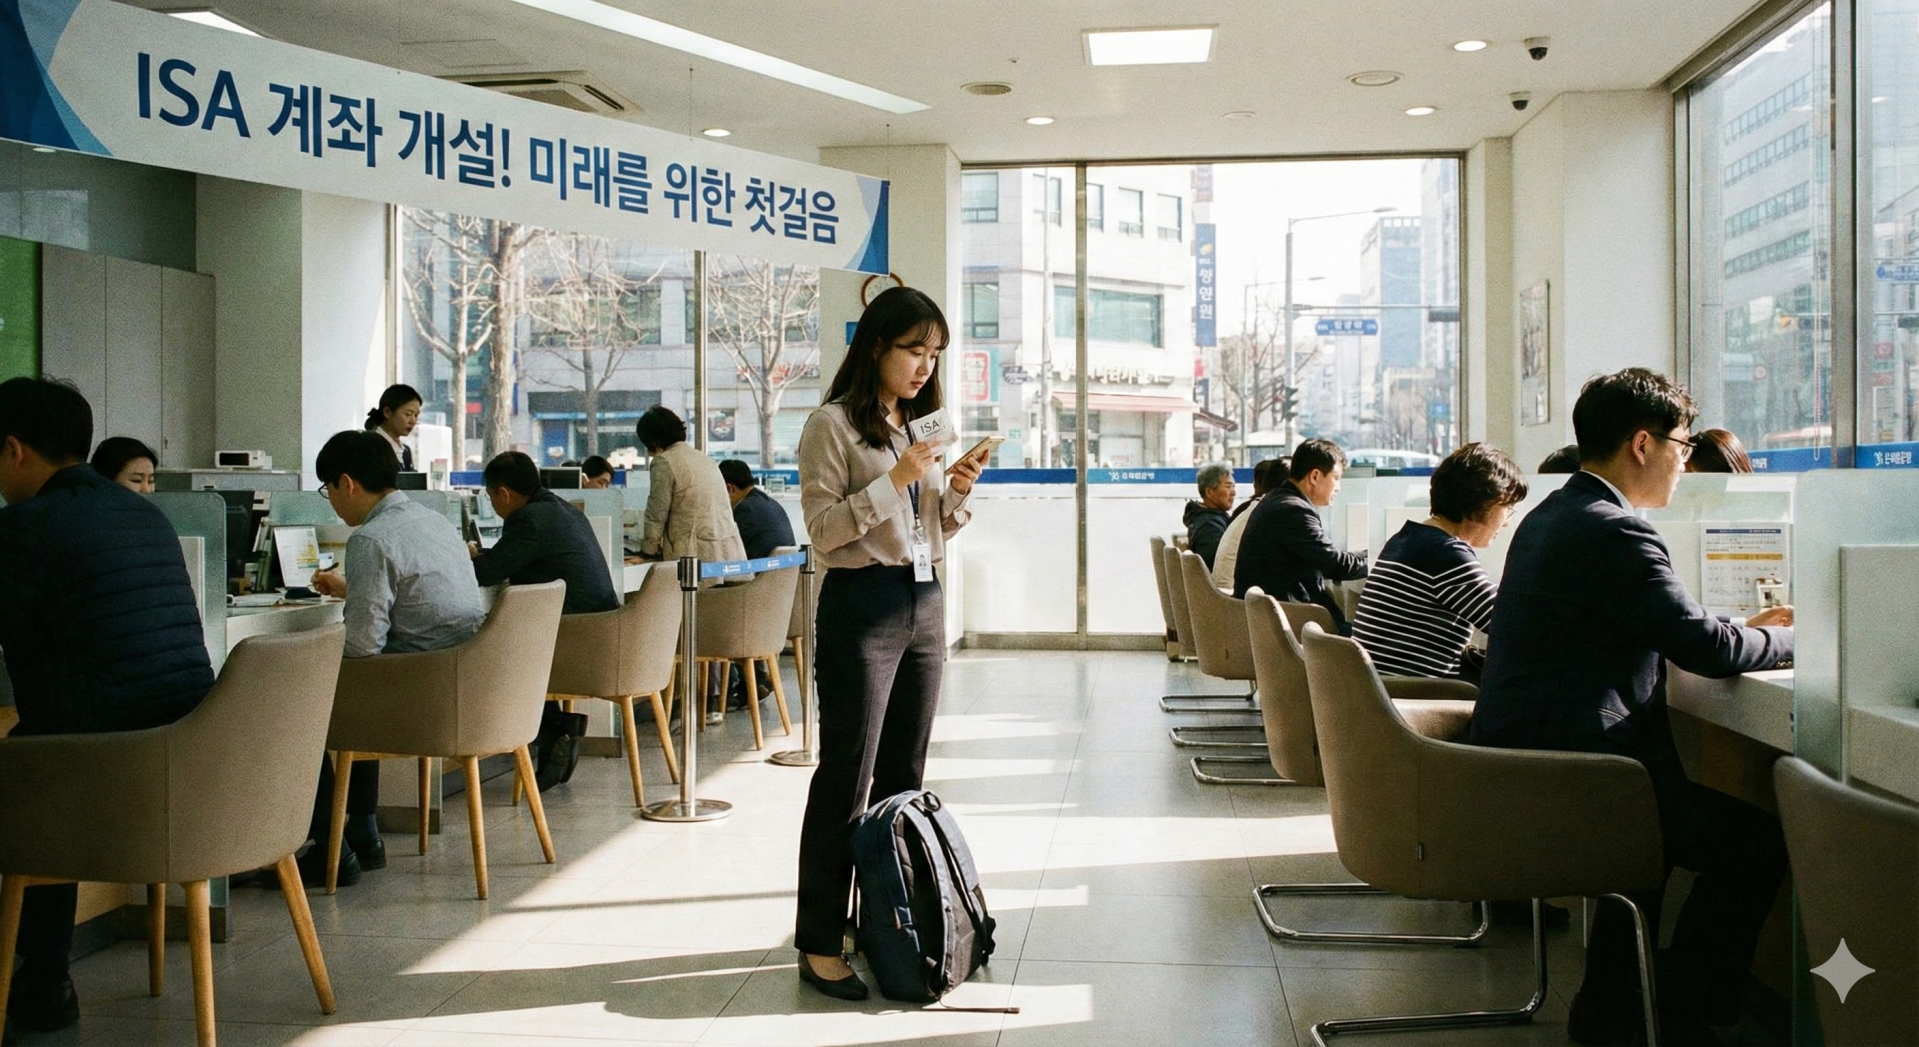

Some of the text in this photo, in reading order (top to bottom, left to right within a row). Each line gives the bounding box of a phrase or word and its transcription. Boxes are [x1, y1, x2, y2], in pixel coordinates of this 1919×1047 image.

[137, 52, 839, 245] ISA 계좌 개설! 미래를 위한 첫걸음
[920, 419, 940, 434] ISA
